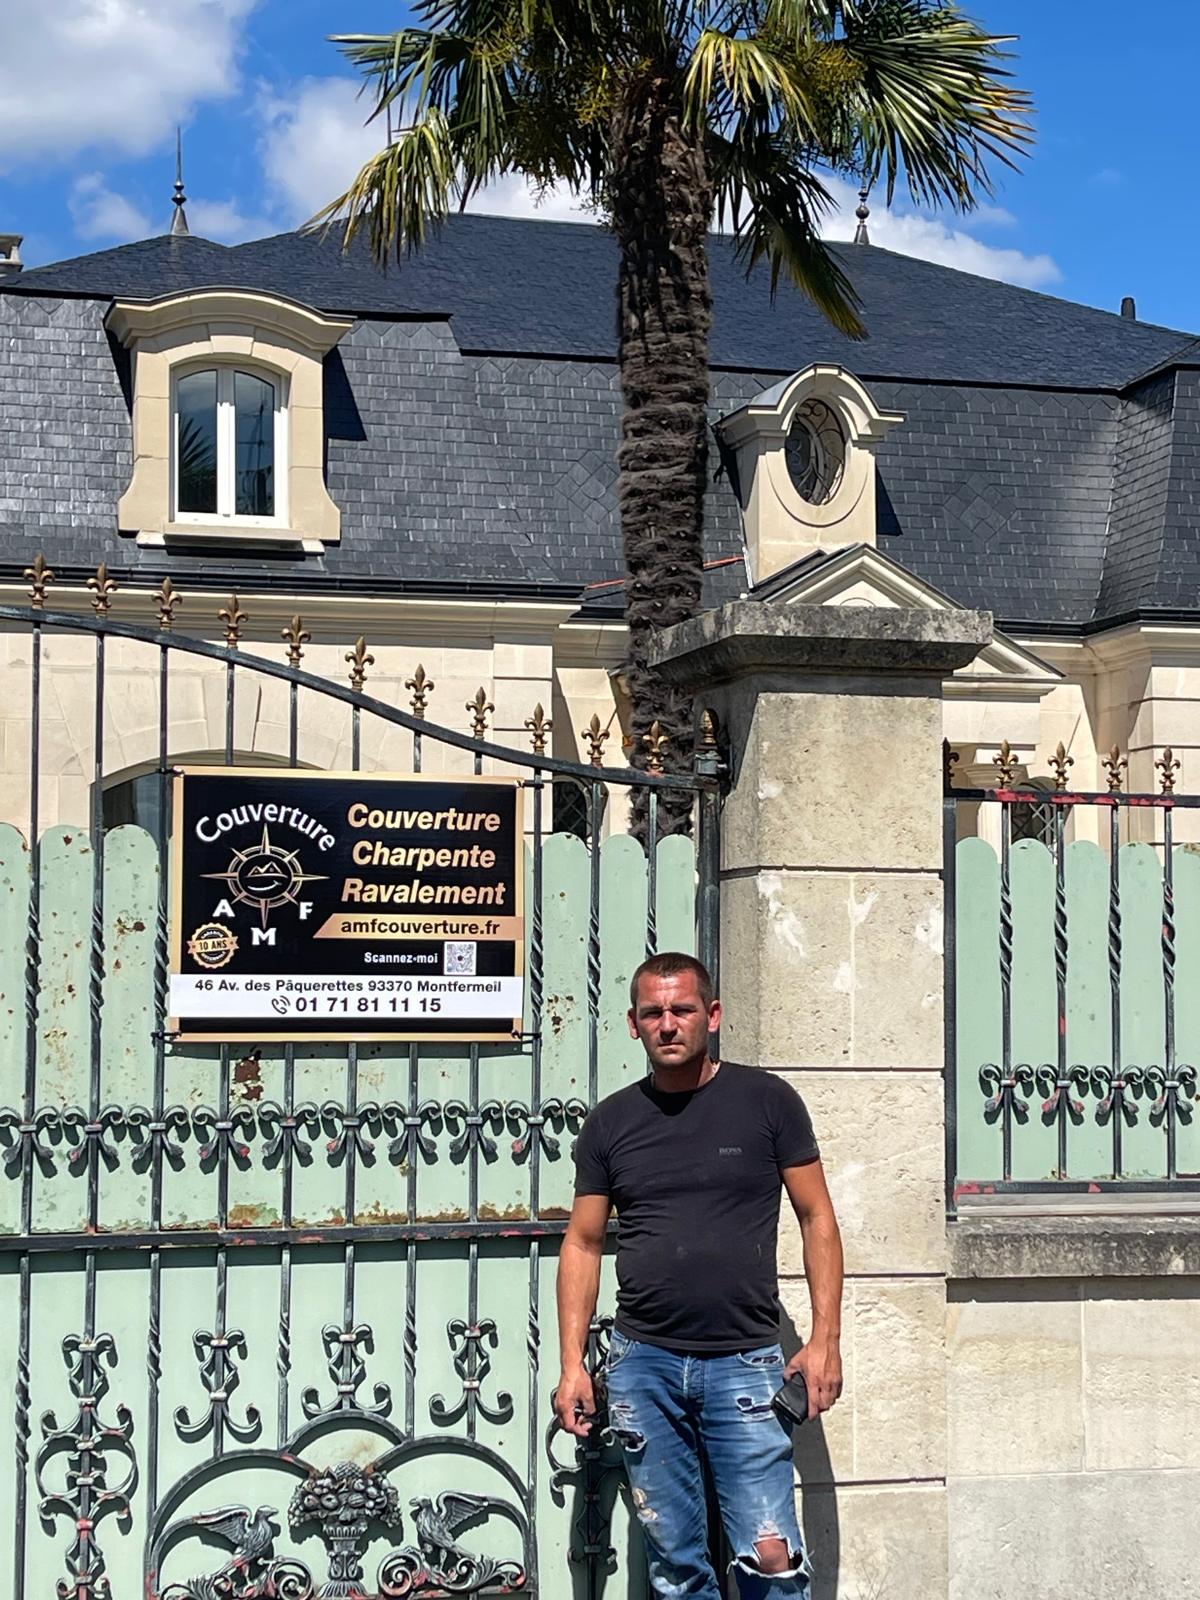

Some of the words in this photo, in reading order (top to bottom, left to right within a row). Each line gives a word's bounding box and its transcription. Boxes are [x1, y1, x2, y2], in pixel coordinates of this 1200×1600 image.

[195, 803, 336, 852] Couverture
[347, 803, 501, 832] Couverture
[352, 840, 496, 872] Charpente
[341, 878, 506, 906] Ravalement
[212, 898, 235, 918] A
[251, 927, 276, 946] M
[299, 901, 313, 920] F
[341, 918, 500, 937] amfcouverture.fr
[198, 942, 208, 951] 10
[211, 940, 227, 950] ANS
[364, 951, 438, 964] Scannez-moi
[195, 980, 213, 991] 46
[218, 980, 240, 992] Av.
[245, 980, 271, 992] des
[275, 980, 364, 994] Pâquerettes
[368, 981, 413, 993] 93370
[417, 980, 502, 993] Montfermeil
[295, 998, 318, 1012] 01
[327, 998, 348, 1012] 71
[357, 998, 379, 1012] 81
[391, 998, 409, 1012] 11
[419, 998, 441, 1013] 15
